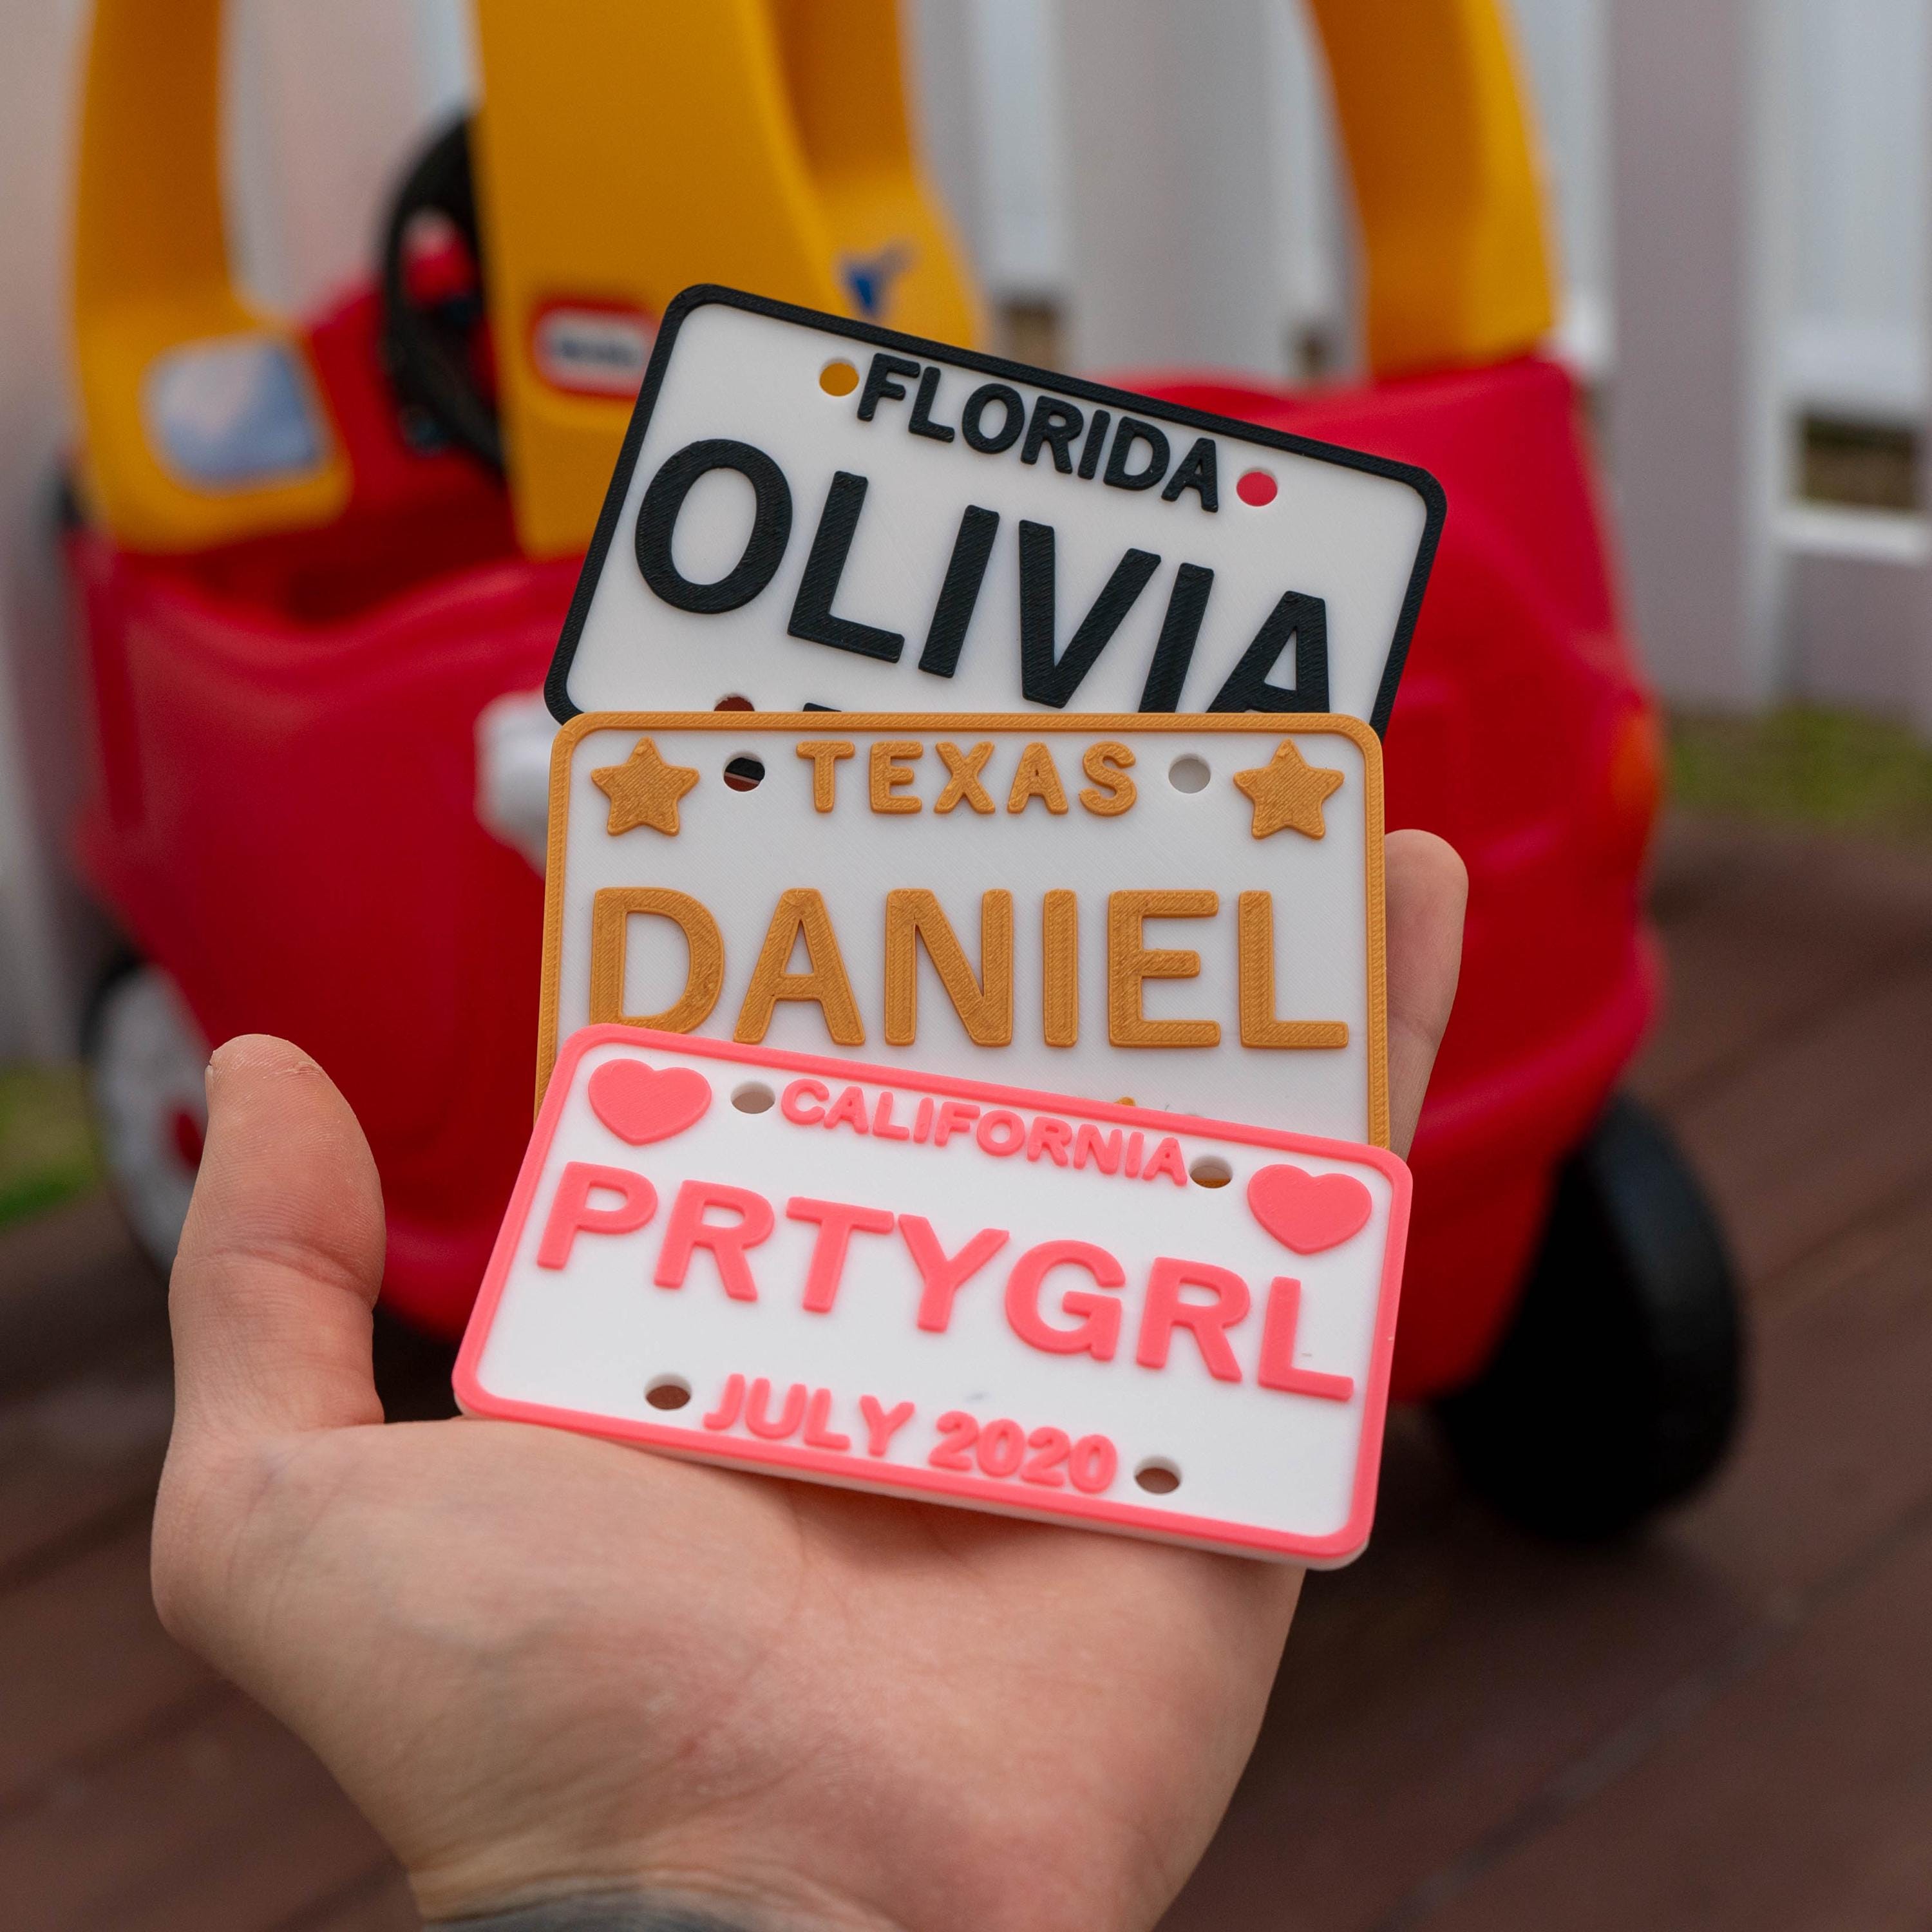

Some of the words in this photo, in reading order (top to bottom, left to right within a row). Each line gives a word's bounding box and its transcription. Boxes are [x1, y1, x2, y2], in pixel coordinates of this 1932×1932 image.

[857, 353, 1219, 513] FLORIDA
[634, 439, 1331, 712] OLIVIA
[796, 741, 1137, 816] TEXAS
[591, 888, 1349, 1049] DANIEL
[781, 1079, 1188, 1186] CALIFORNIA
[537, 1162, 1354, 1401] PRTYGRL
[705, 1374, 915, 1456] JULY
[931, 1410, 1117, 1495] 2020
